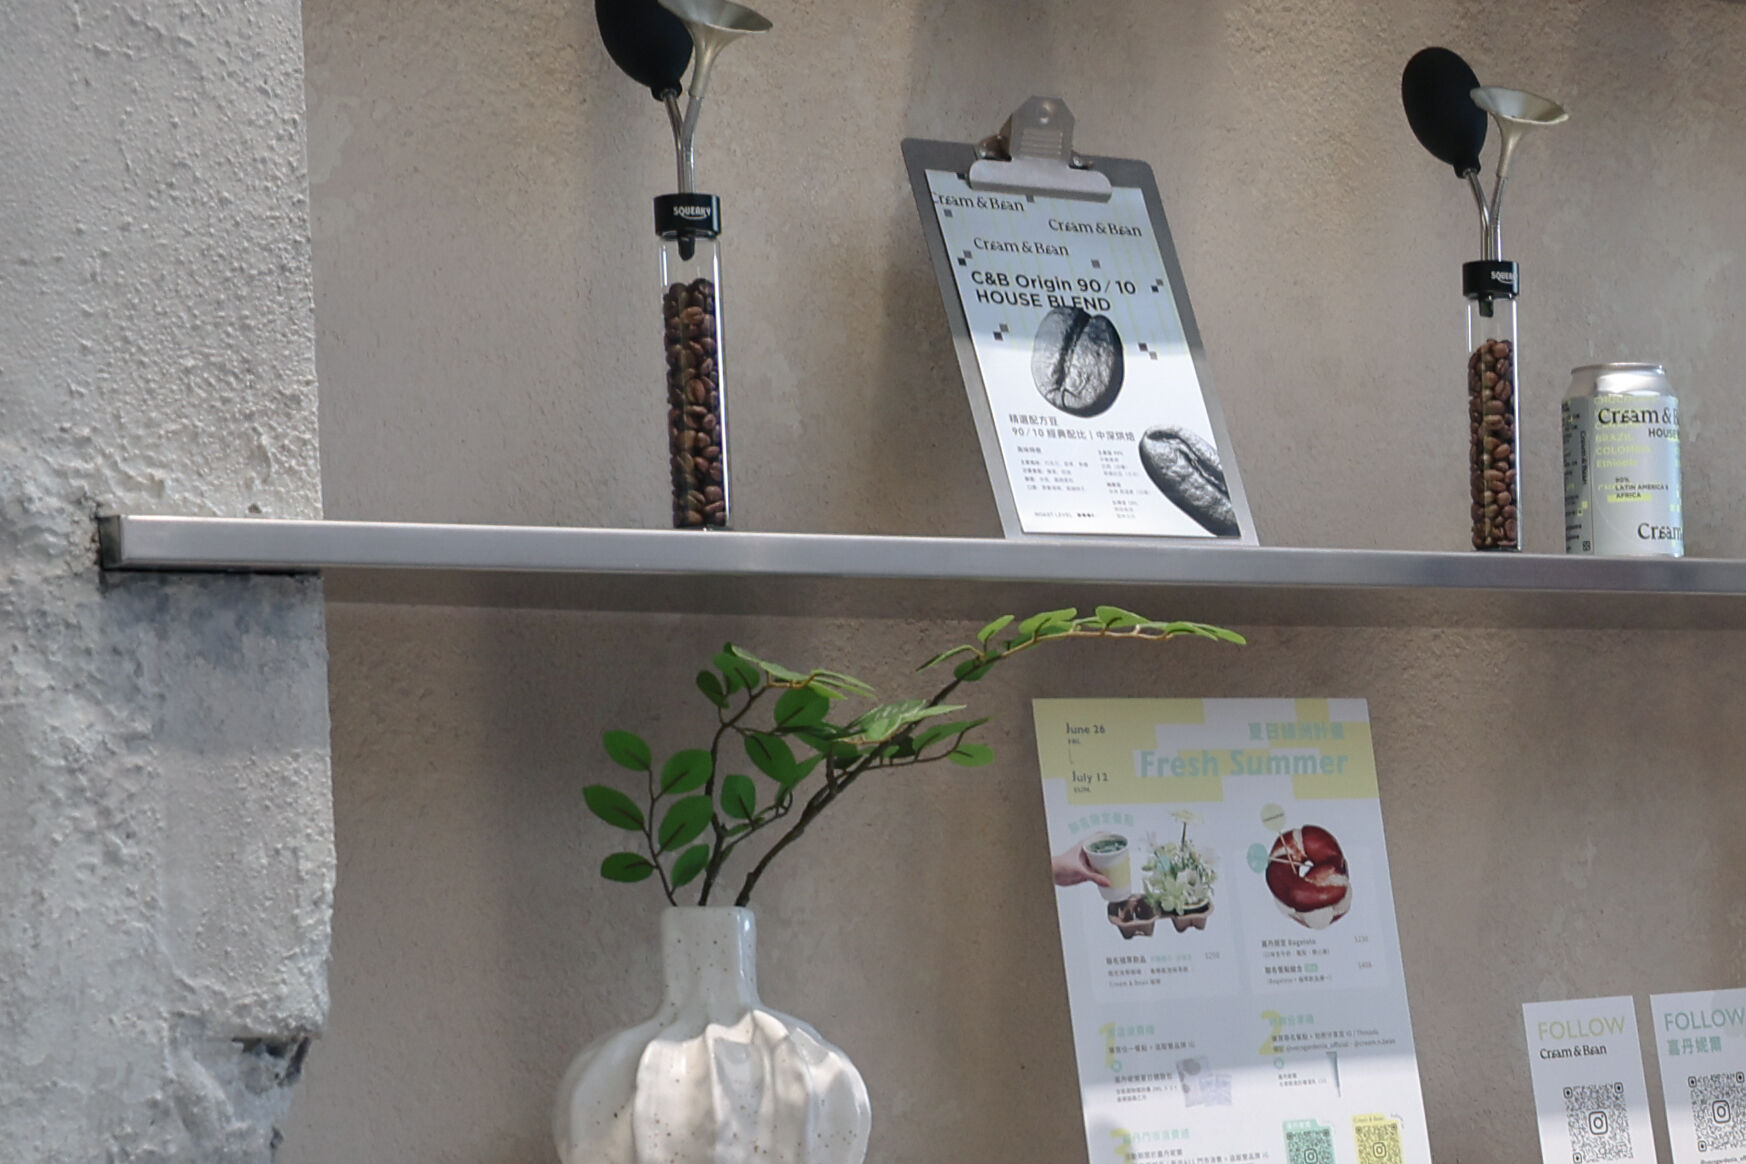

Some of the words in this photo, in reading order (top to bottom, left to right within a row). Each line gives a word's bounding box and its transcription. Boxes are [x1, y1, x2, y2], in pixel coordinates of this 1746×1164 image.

[990, 197, 1025, 212] Bean
[1048, 218, 1093, 234] Cream
[1095, 222, 1107, 234] &
[1109, 223, 1143, 238] Bean
[974, 237, 1018, 253] Cream
[1021, 241, 1032, 253] &
[1034, 242, 1069, 256] Bean
[971, 270, 1010, 287] C&B
[1015, 273, 1072, 294] Origin
[976, 289, 1043, 307] HOUSE
[1049, 294, 1112, 312] BLEND
[1597, 407, 1659, 425] Cream
[1066, 722, 1090, 735] June
[1093, 724, 1106, 735] 26
[1140, 749, 1219, 778] Fresh
[1229, 748, 1349, 776] Summer
[1072, 770, 1093, 784] July
[1096, 772, 1109, 782] 12
[1537, 1016, 1626, 1041] FOLLOW
[1664, 1007, 1746, 1032] FOLLOW
[1540, 1047, 1573, 1060] Cream
[1582, 1044, 1608, 1057] Bean
